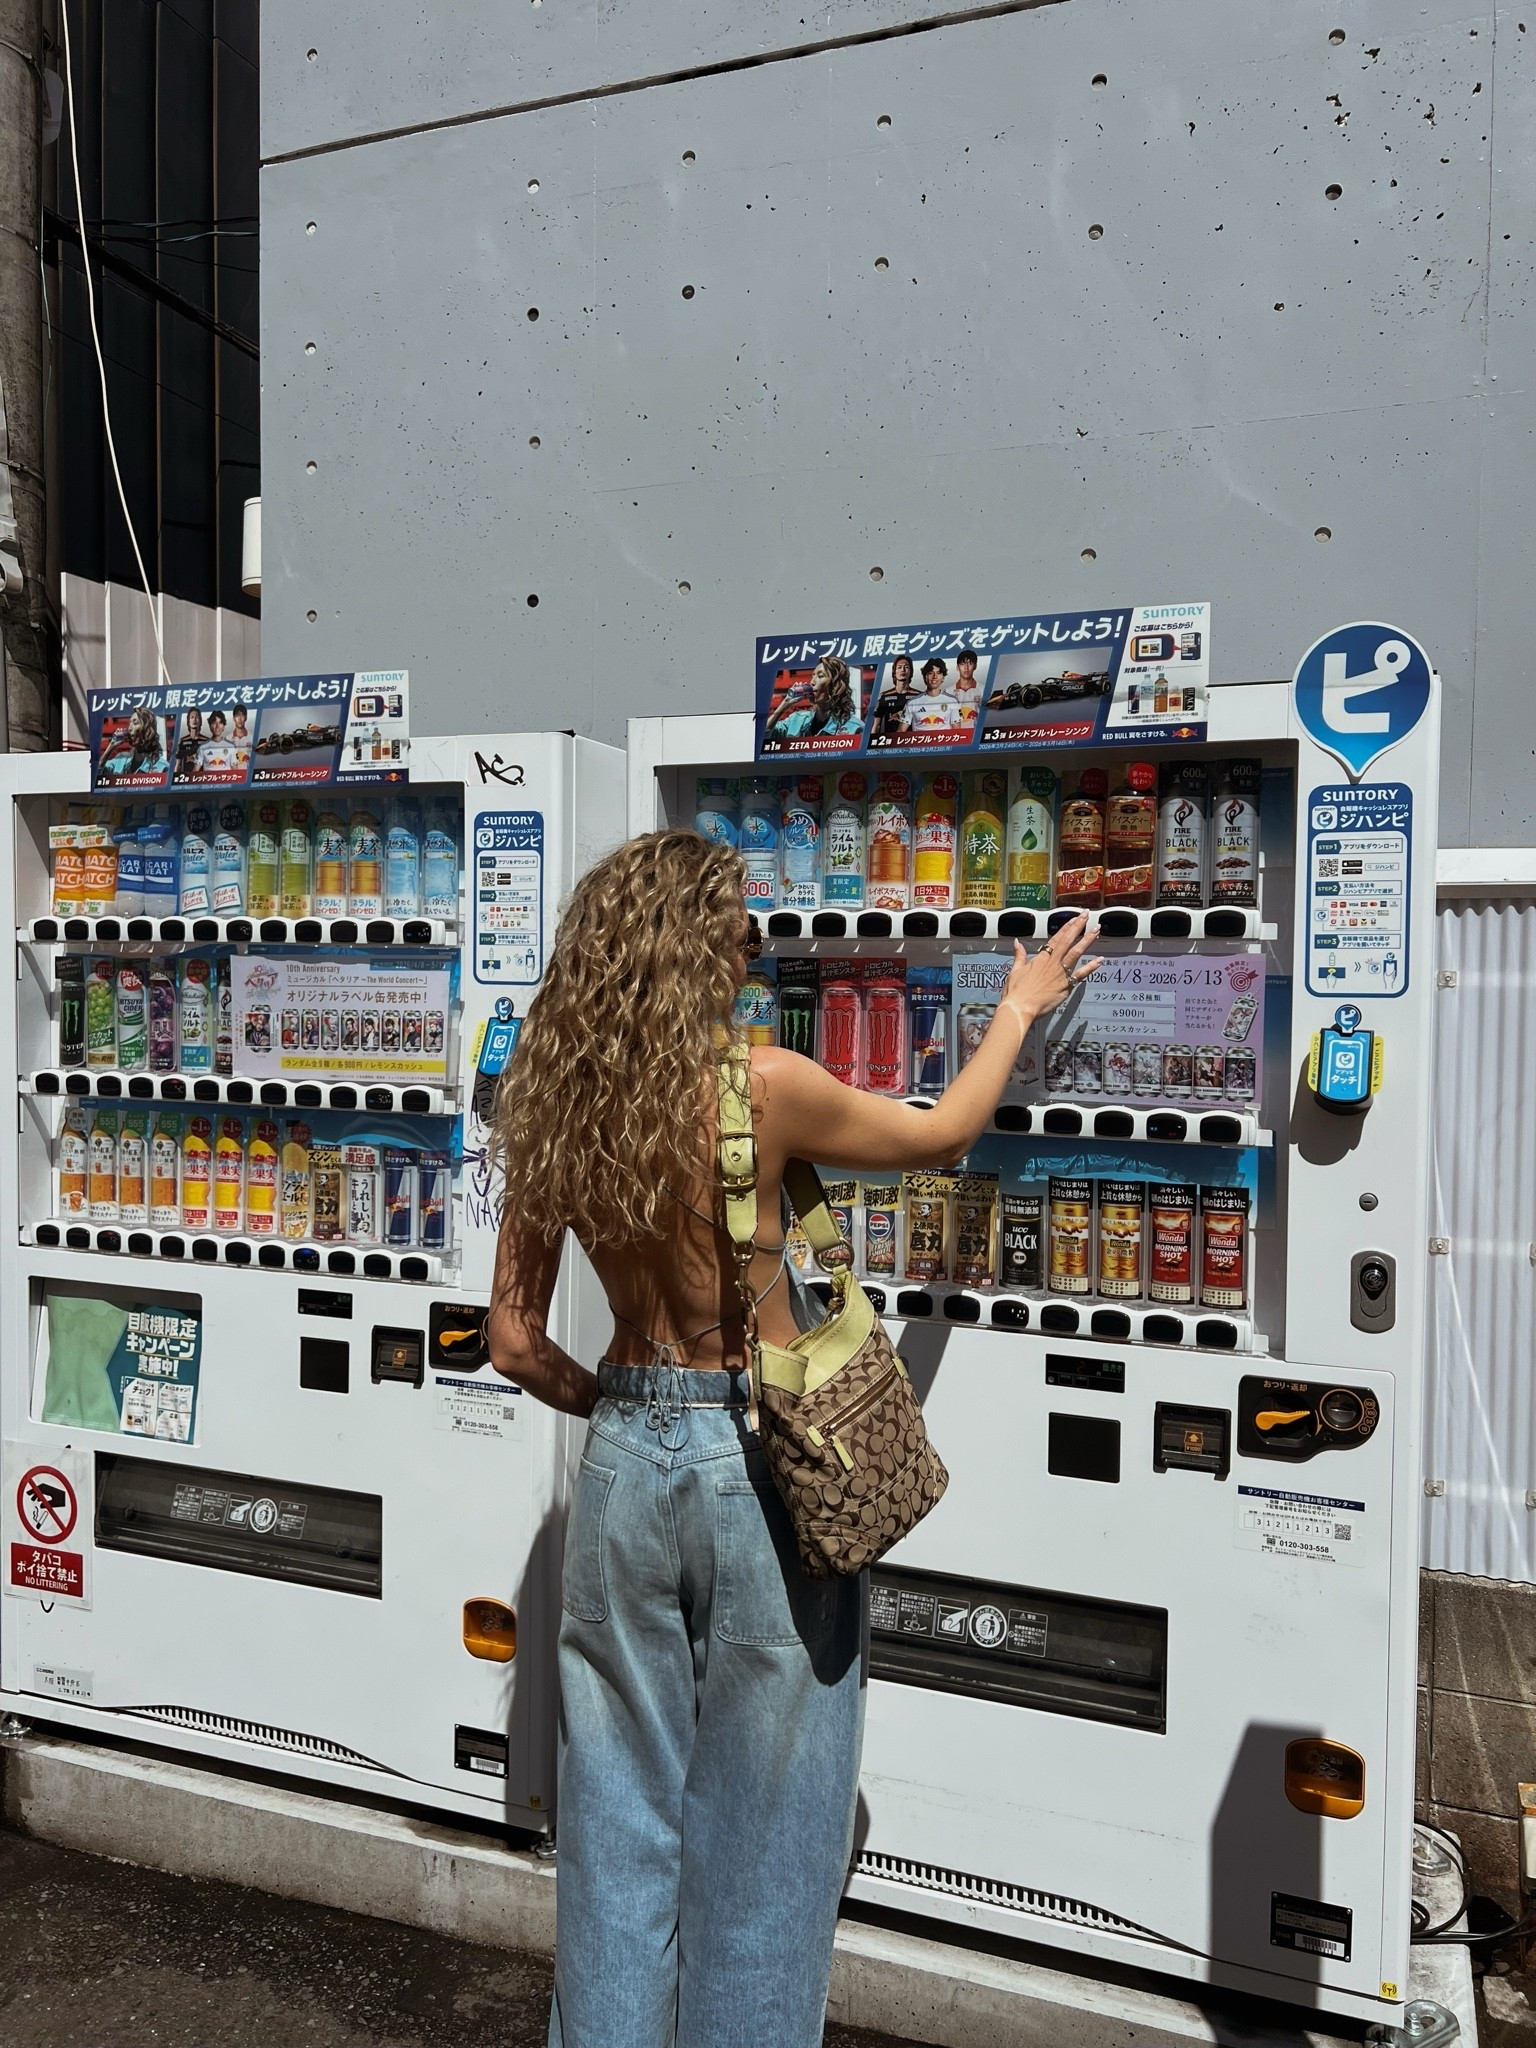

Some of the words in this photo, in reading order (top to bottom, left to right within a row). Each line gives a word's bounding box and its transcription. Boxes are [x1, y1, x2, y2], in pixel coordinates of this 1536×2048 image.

[1143, 606, 1204, 618] SUNTORY
[1134, 622, 1193, 632] ご応募はこちらから!
[762, 638, 858, 664] レッドブル
[862, 616, 1124, 658] 限定グッズをゲットしよう!
[361, 672, 404, 683] SUNTORY
[1322, 640, 1410, 734] ピ
[92, 689, 162, 712] レッドブル
[165, 679, 349, 709] 限定グッズをゲットしよう!
[984, 730, 1007, 740] 第3弾
[1008, 726, 1090, 738] レッドブル・レーシング
[1114, 732, 1128, 740] BULL
[790, 741, 810, 750] ZETA
[812, 740, 853, 748] DIVISION
[872, 736, 892, 747] 第2弾
[897, 734, 966, 744] レッドブル・サッカー
[116, 778, 130, 786] ZETA
[131, 776, 162, 786] DIVISION
[1322, 789, 1398, 802] SUNTORY
[484, 816, 534, 826] SUNTORY
[1026, 806, 1036, 826] 生茶
[1110, 814, 1149, 824] アイスティー
[1340, 812, 1409, 828] ジハンピ
[790, 818, 808, 827] うめ
[496, 835, 542, 847] ジハンピ
[832, 834, 854, 842] ライム
[1166, 838, 1198, 848] BLACK
[1217, 836, 1250, 846] BLACK
[323, 838, 346, 857] 麦茶
[357, 837, 380, 856] 麦茶
[832, 843, 854, 852] ソルト
[964, 834, 1000, 856] 特茶
[976, 856, 984, 866] S
[782, 896, 816, 906] 塩分補給
[287, 964, 300, 973] 10th
[302, 965, 340, 974] Anniversary
[822, 960, 850, 970] トロピカル
[864, 960, 894, 970] トロピカル
[958, 964, 972, 972] THE
[378, 976, 394, 984] World
[287, 990, 428, 1004] オリジナルラベル缶発売中!
[744, 986, 760, 998] 600
[1094, 992, 1126, 1001] ランダム
[1132, 993, 1162, 1002] 全8種類
[124, 1004, 143, 1012] CIDER
[500, 1001, 509, 1013] ピ
[750, 1000, 777, 1020] 麦茶
[1112, 1008, 1145, 1018] 各900円
[1340, 1009, 1356, 1024] ピ
[1096, 1024, 1158, 1034] レモンスカッシュ
[370, 1061, 423, 1070] レモンスカッシュ
[1330, 1075, 1357, 1084] タッチ
[345, 1152, 376, 1164] 満足感
[1052, 1180, 1089, 1188] いいはじまりは
[1102, 1183, 1140, 1192] いいはじまりは
[864, 1184, 900, 1206] 強刺激
[1050, 1188, 1091, 1199] 上質な休憩から
[1100, 1190, 1143, 1202] 上質な休憩から
[1152, 1194, 1194, 1205] 朝のはじまりに
[1202, 1197, 1246, 1208] 朝のはじまりに
[1004, 1232, 1038, 1250] BLACK
[1158, 1233, 1184, 1242] Wonda
[1210, 1237, 1236, 1246] Wonda
[1155, 1244, 1188, 1252] MORNING
[1206, 1248, 1240, 1257] MORNING
[1160, 1252, 1182, 1260] SHOT
[1212, 1255, 1234, 1263] SHOT
[128, 1312, 198, 1338] 自販機限定
[126, 1332, 196, 1358] キャンペーン
[138, 1356, 178, 1377] 実施中!
[132, 1386, 154, 1396] チェック!
[1263, 1380, 1308, 1392] おつり・返却
[1247, 1488, 1356, 1508] サントリー自動販売機お客様センター
[1280, 1540, 1330, 1553] 0120-303-558
[32, 1550, 62, 1566] タバコ
[16, 1561, 78, 1584] ポイ捨て禁止
[25, 1576, 36, 1585] NO
[36, 1577, 68, 1592] LITTERING
